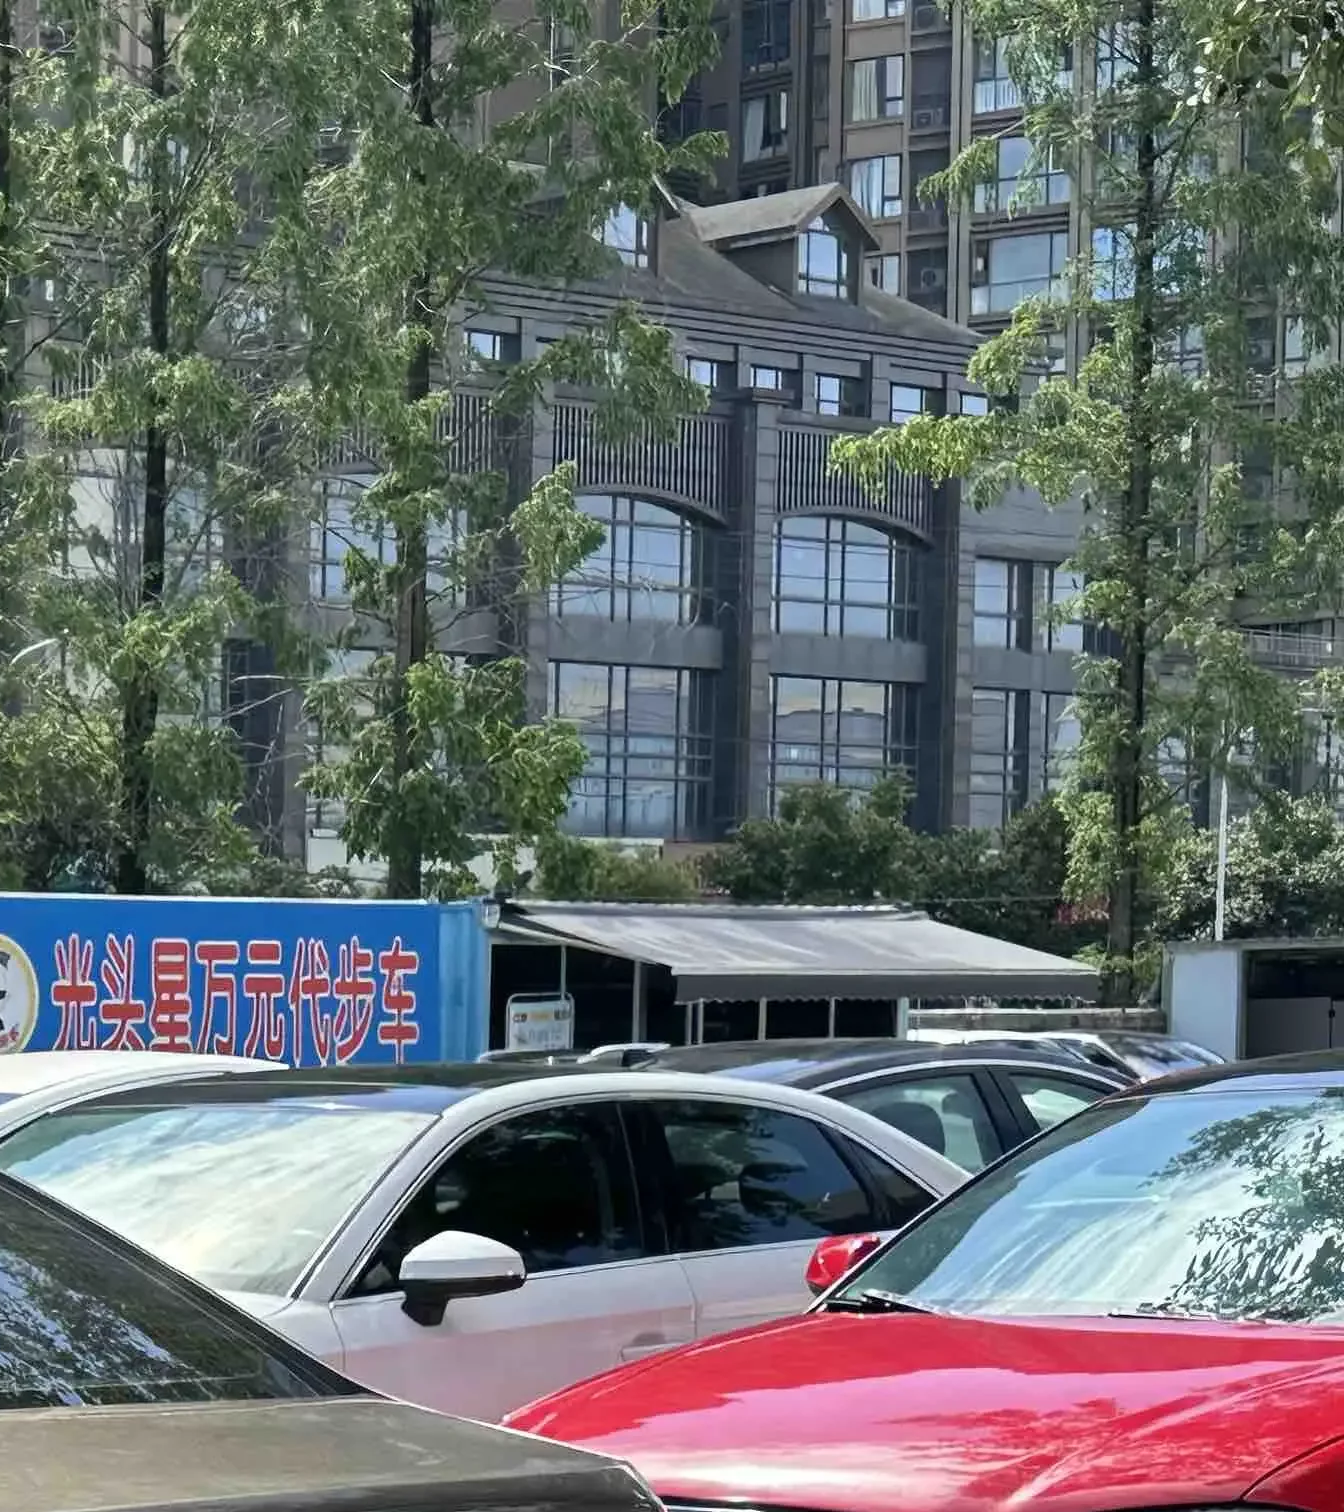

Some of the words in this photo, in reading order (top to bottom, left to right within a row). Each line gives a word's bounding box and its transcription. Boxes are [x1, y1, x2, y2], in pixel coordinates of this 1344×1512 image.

[50, 932, 420, 1068] 光头星万元代步车
